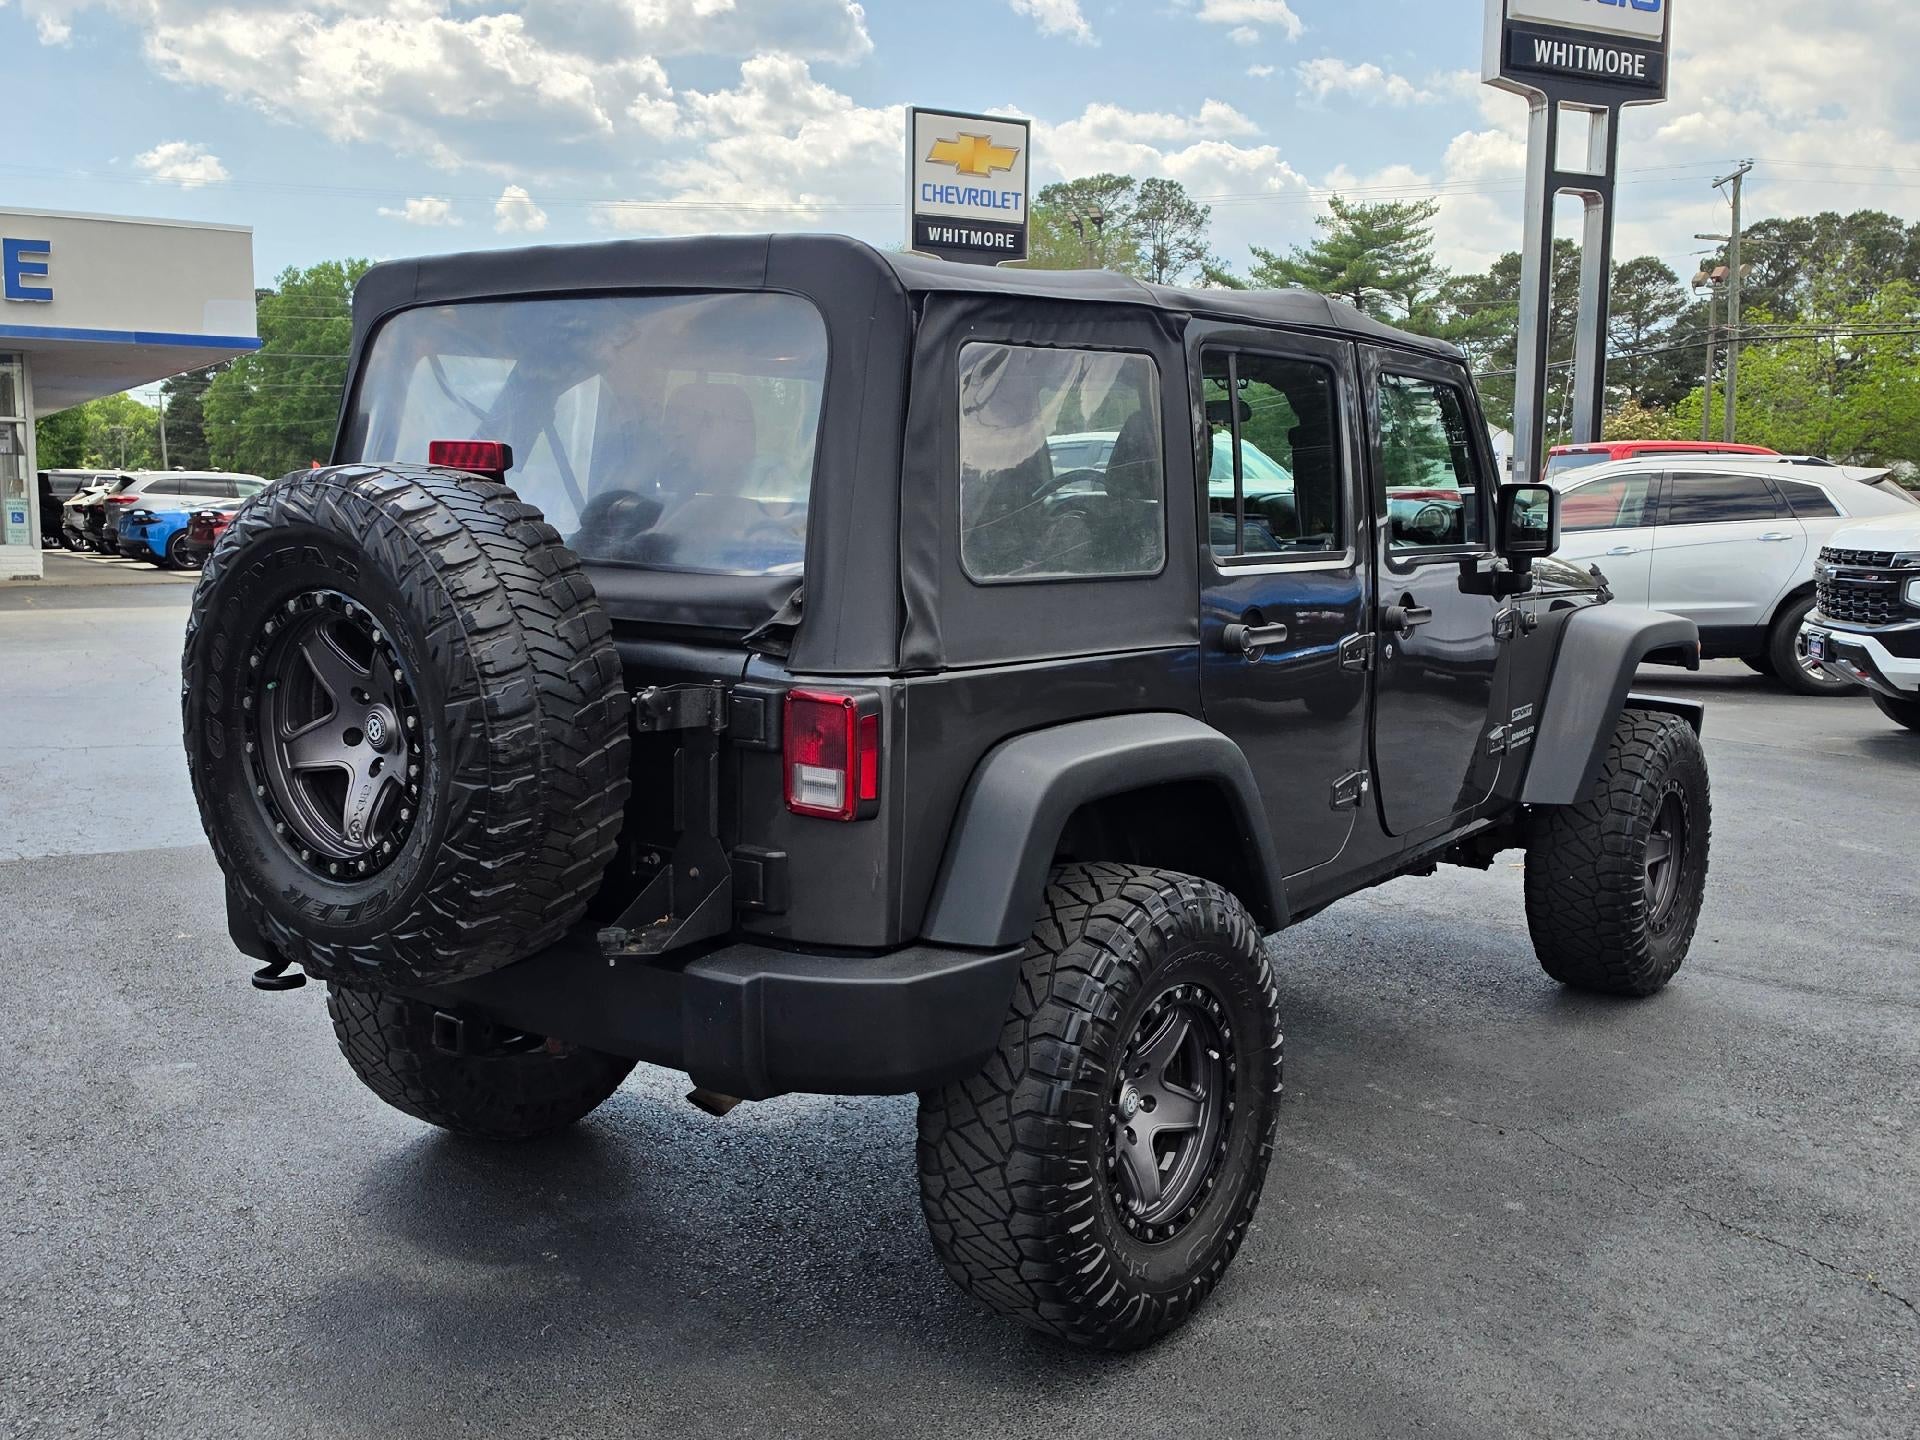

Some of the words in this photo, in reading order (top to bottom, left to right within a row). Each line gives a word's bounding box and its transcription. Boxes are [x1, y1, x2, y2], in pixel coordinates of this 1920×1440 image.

[1534, 38, 1646, 78] WHITMORE
[921, 183, 1022, 210] CHEVROLET
[928, 226, 1015, 248] WHITMORE
